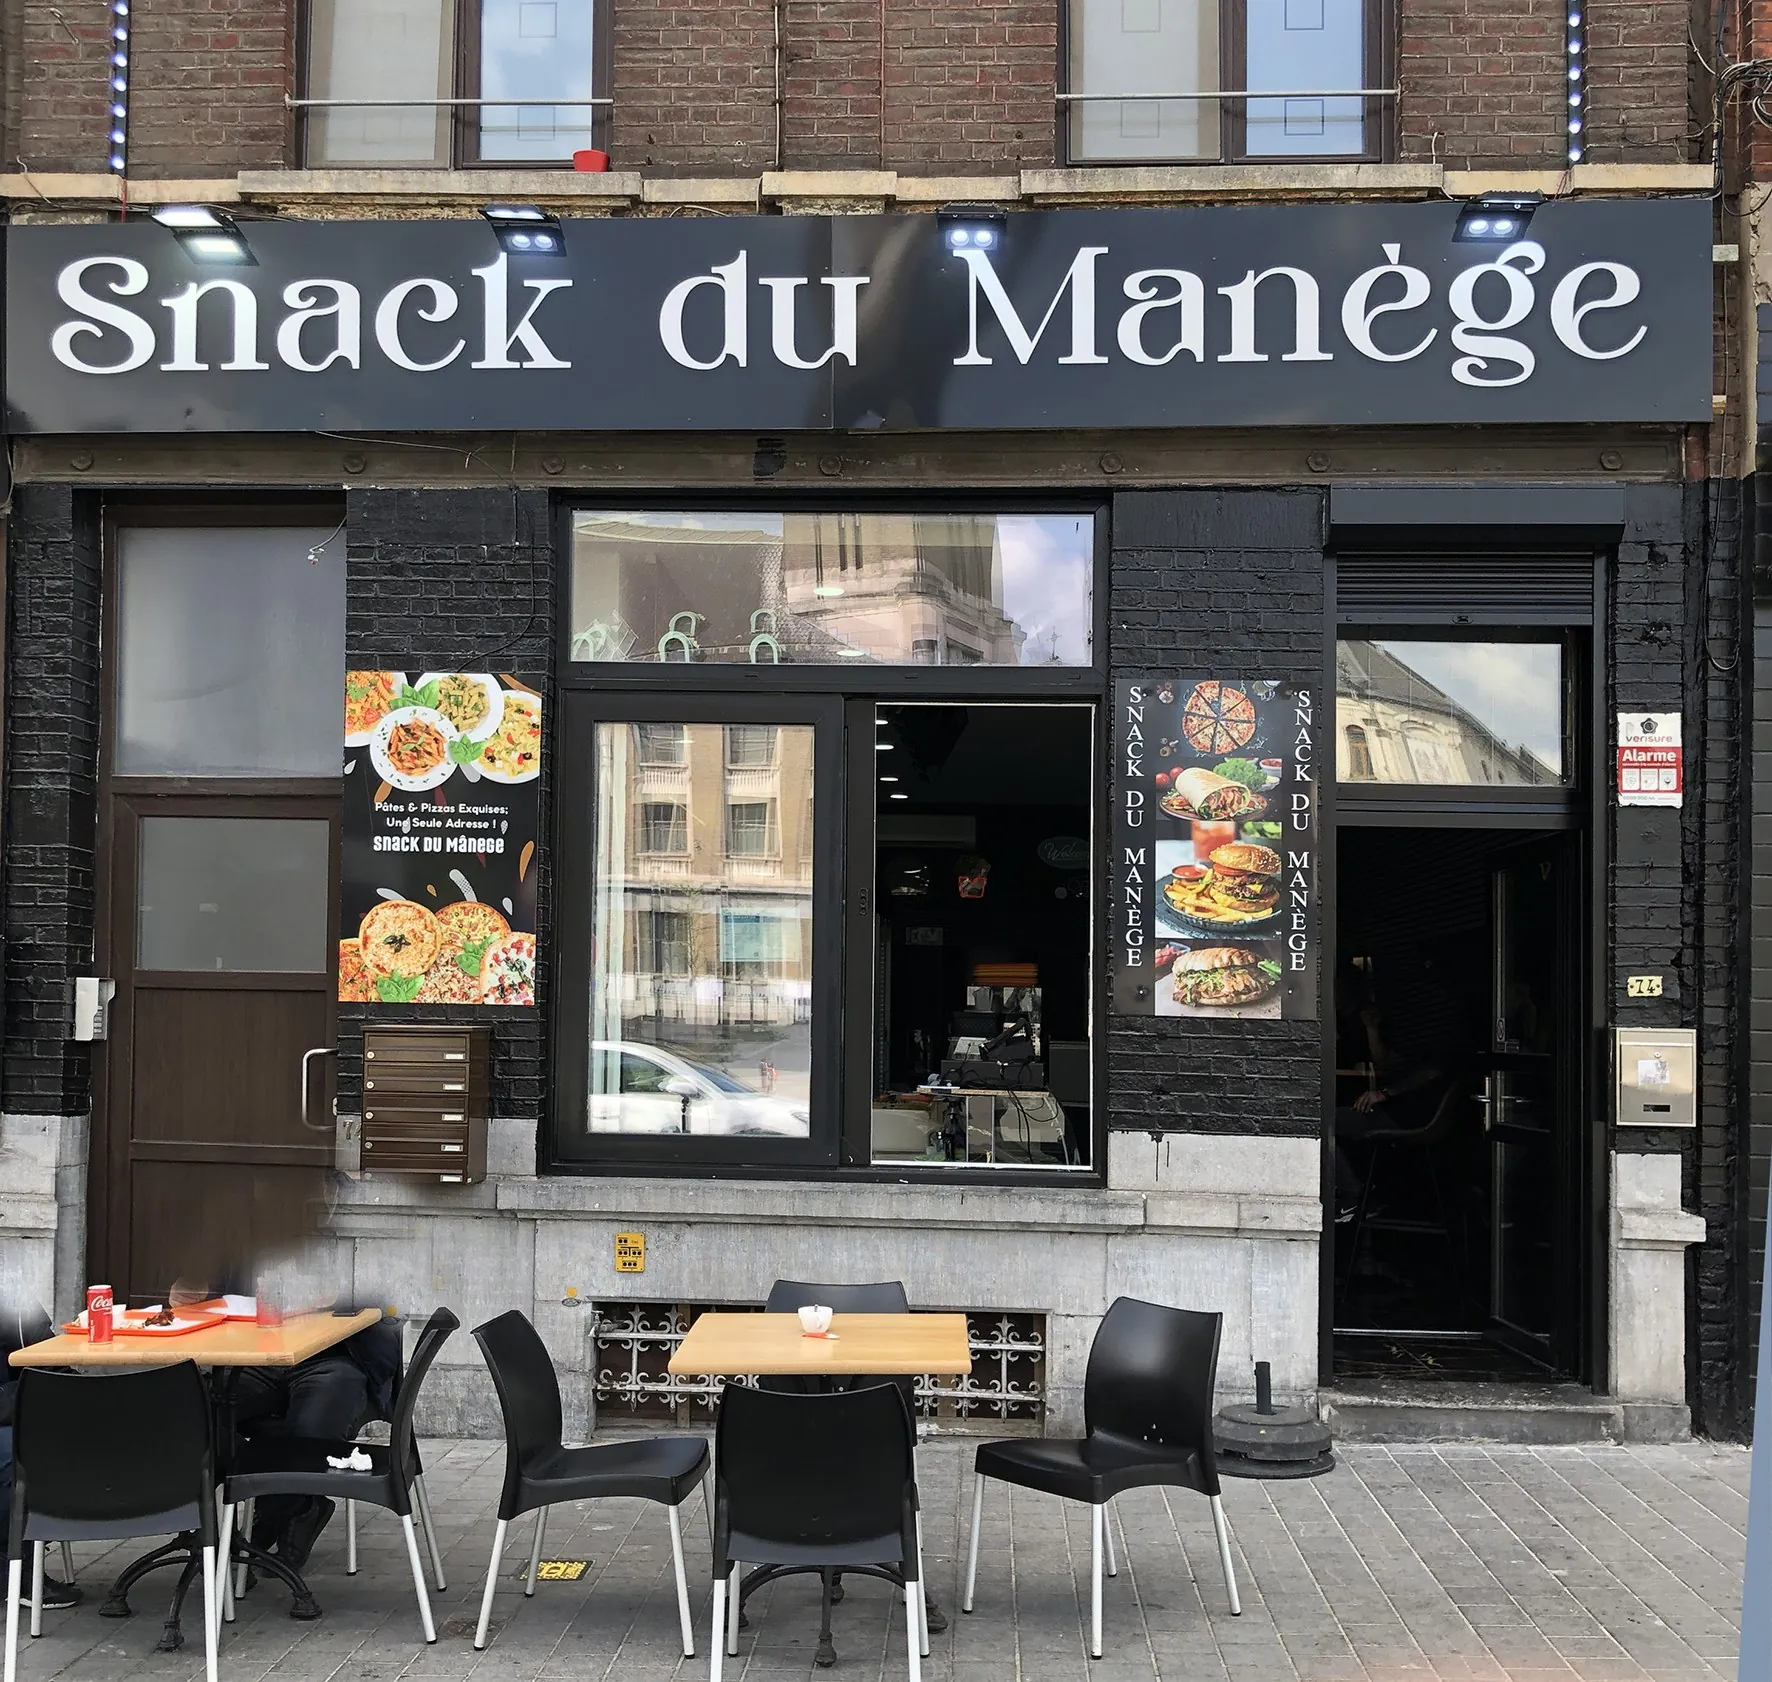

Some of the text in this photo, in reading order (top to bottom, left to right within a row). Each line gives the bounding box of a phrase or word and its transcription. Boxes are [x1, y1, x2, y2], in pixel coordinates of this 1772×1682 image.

[51, 241, 1649, 388] Snack du Manège
[1625, 735, 1673, 743] verisure
[1622, 749, 1677, 762] Alarme
[374, 801, 405, 812] Pâtes
[407, 803, 419, 812] &
[420, 803, 456, 813] Pizzas
[386, 817, 497, 829] Une Seule Adresse !
[1124, 686, 1146, 967] SNACK DU MANÈGE
[1287, 689, 1313, 971] SNACK DU MANÈGE
[423, 836, 442, 853] DU
[1635, 979, 1656, 994] 74
